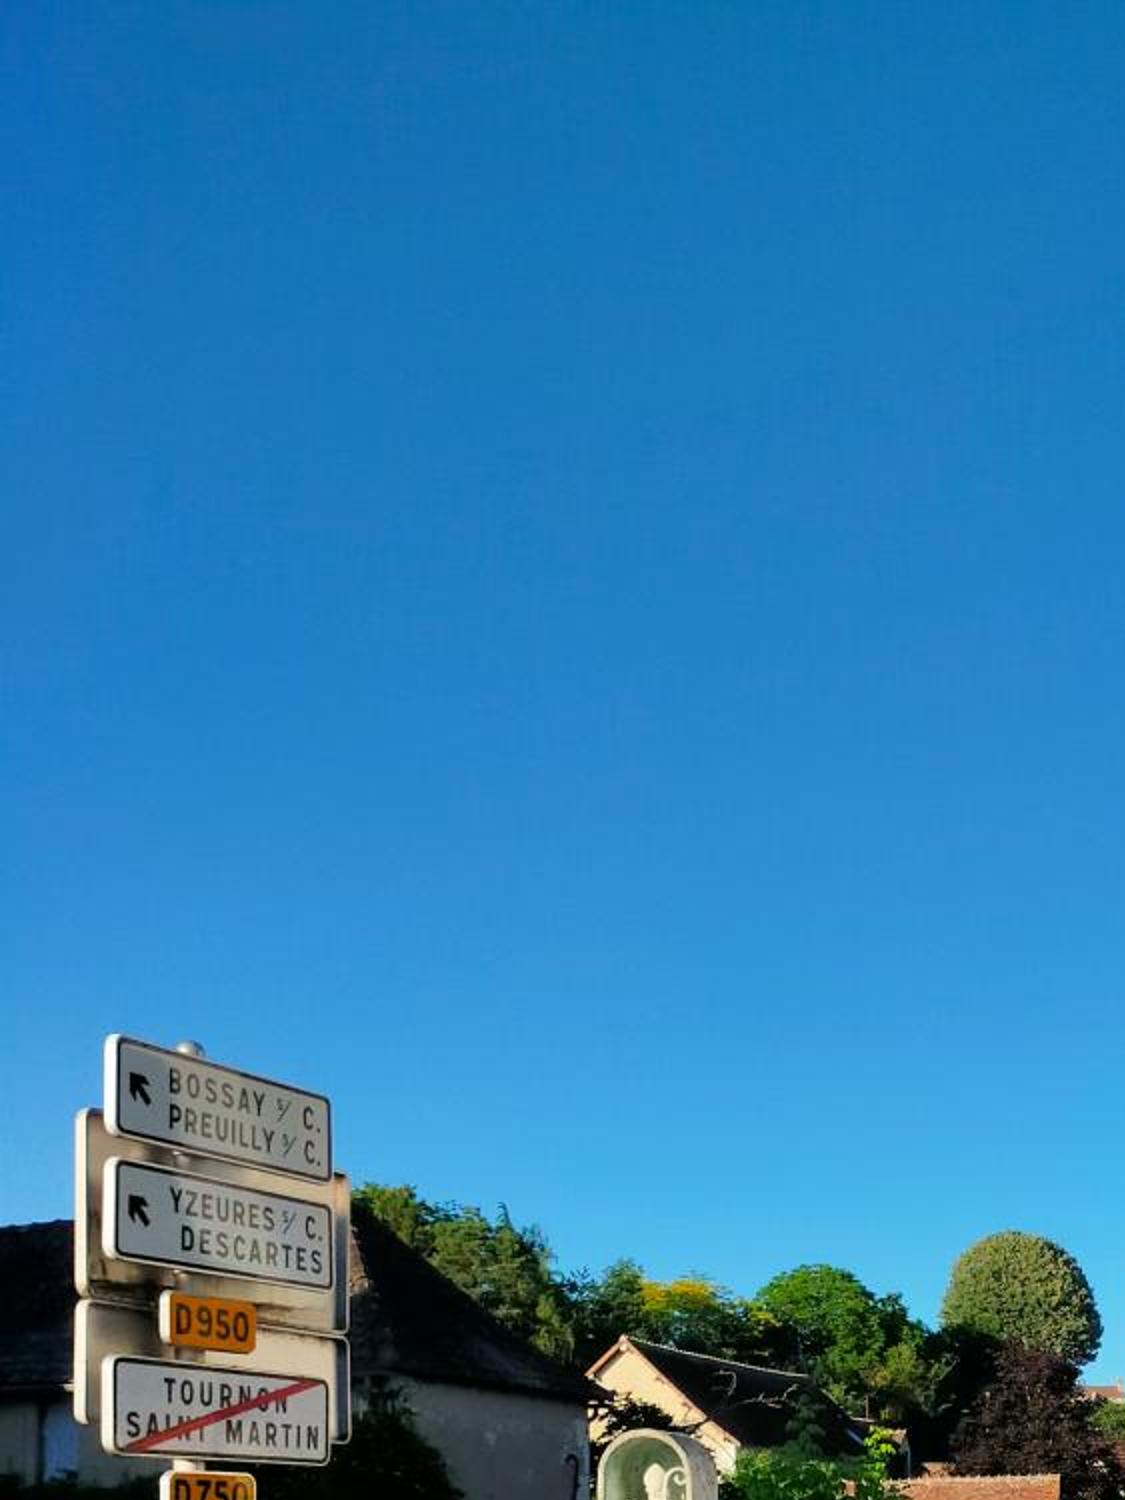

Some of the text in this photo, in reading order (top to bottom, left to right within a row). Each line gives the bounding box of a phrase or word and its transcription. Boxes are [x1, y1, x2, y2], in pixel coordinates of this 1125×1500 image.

[169, 1067, 265, 1117] BOSSAY
[169, 1103, 275, 1153] PREUILLY
[170, 1185, 275, 1231] YZEURES
[181, 1225, 322, 1274] DESCARTES
[163, 1377, 287, 1414] TOURNON
[225, 1419, 319, 1450] MARTIN
